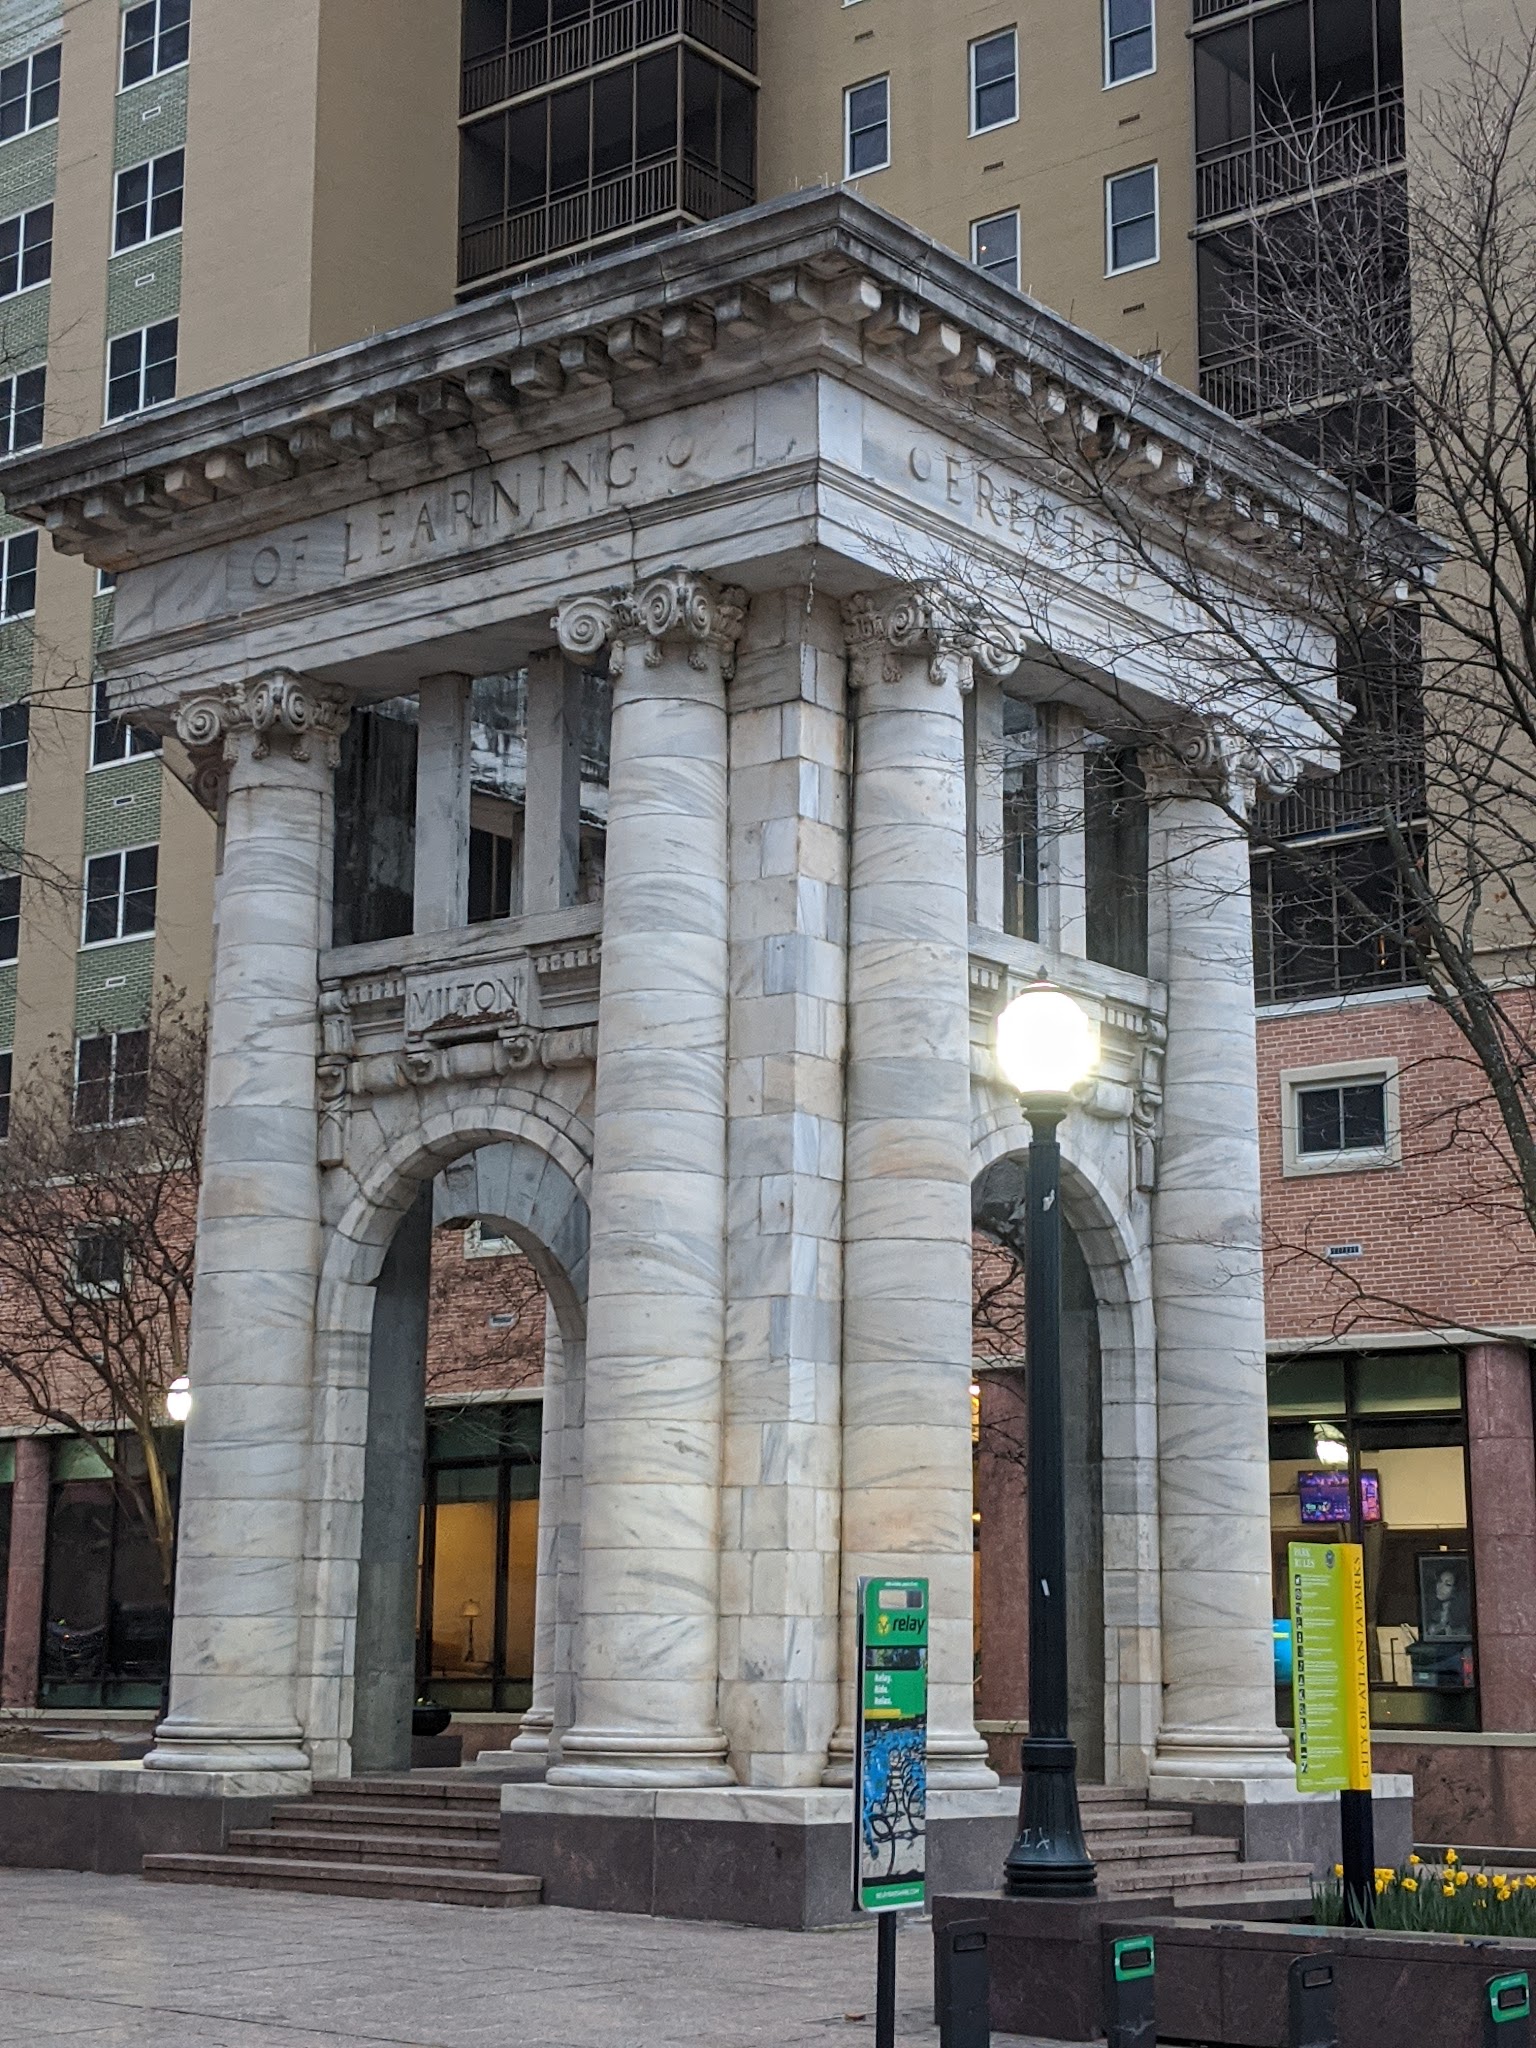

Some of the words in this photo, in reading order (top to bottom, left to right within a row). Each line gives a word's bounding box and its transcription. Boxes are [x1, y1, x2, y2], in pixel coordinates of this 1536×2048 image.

[252, 535, 309, 587] OF
[342, 442, 638, 567] LEARNING
[410, 974, 521, 1030] MILTON
[1353, 1556, 1364, 1611] PARKS
[892, 1615, 926, 1635] relay
[1356, 1617, 1367, 1701] ATLANTA
[1359, 1706, 1368, 1730] OF
[1360, 1735, 1369, 1778] CITY
